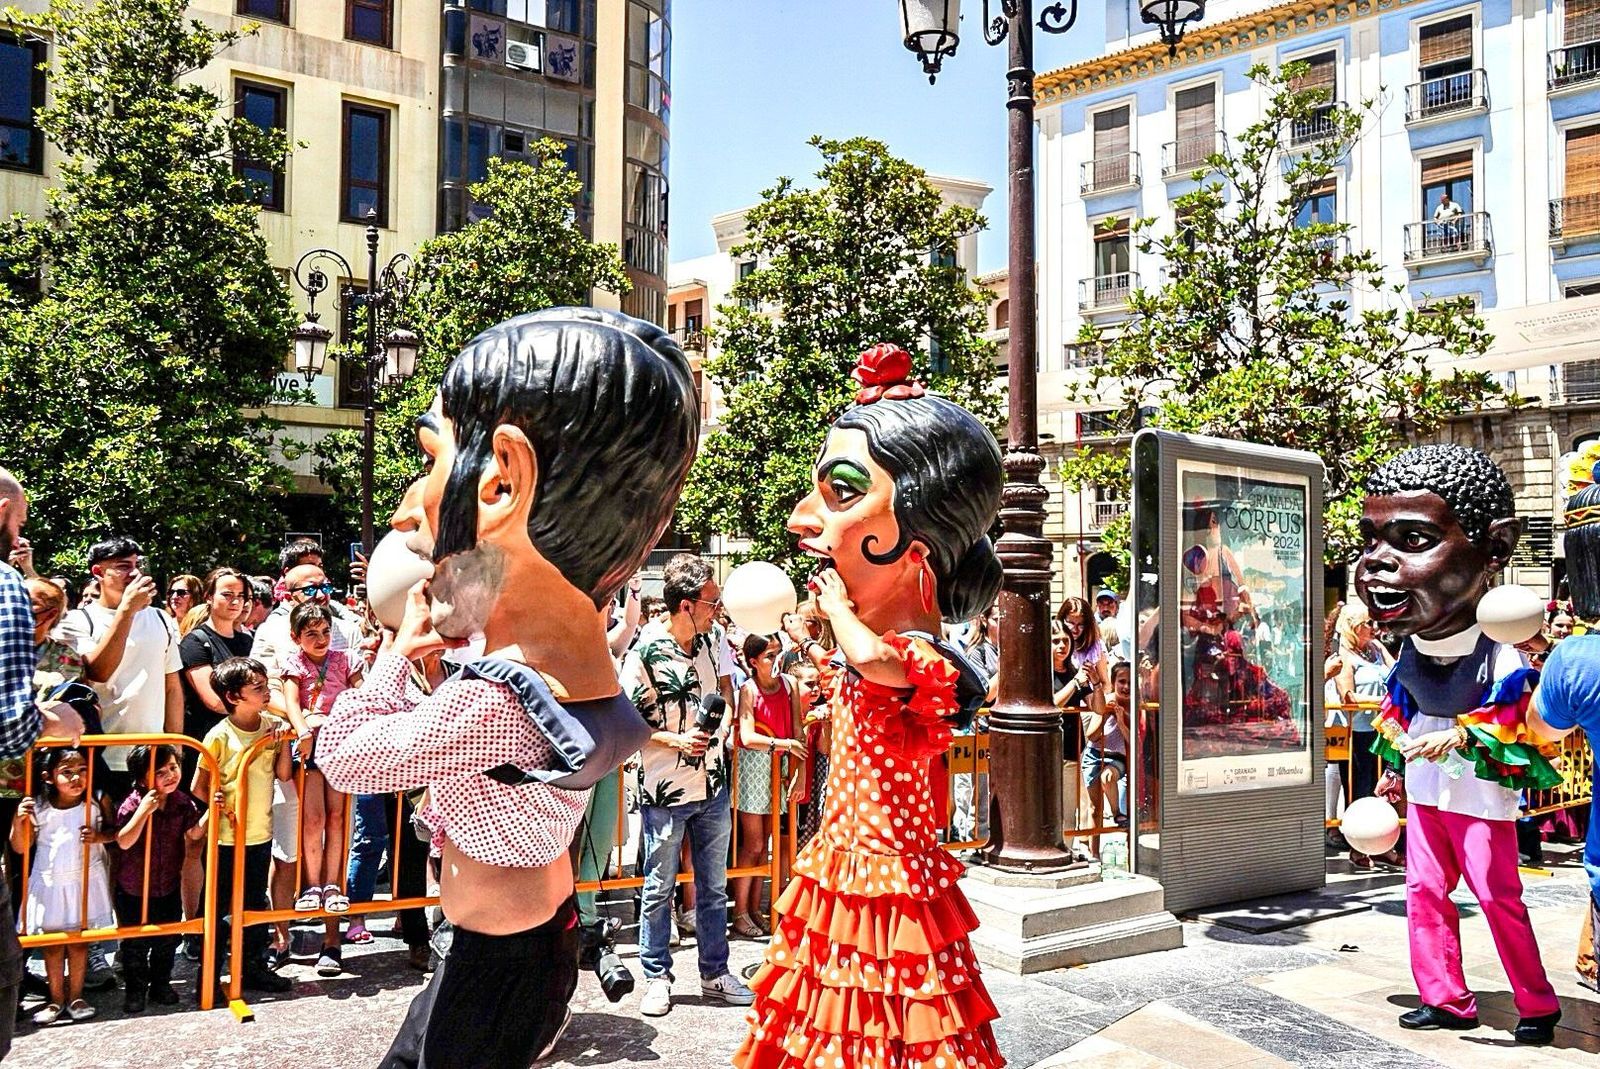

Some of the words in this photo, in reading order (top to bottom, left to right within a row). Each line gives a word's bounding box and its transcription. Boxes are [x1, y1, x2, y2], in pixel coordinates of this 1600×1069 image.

[273, 376, 300, 393] ive
[1248, 493, 1301, 511] GRANADA
[1225, 507, 1301, 538] CORPUS
[1273, 535, 1301, 549] 2024
[954, 746, 971, 759] PL
